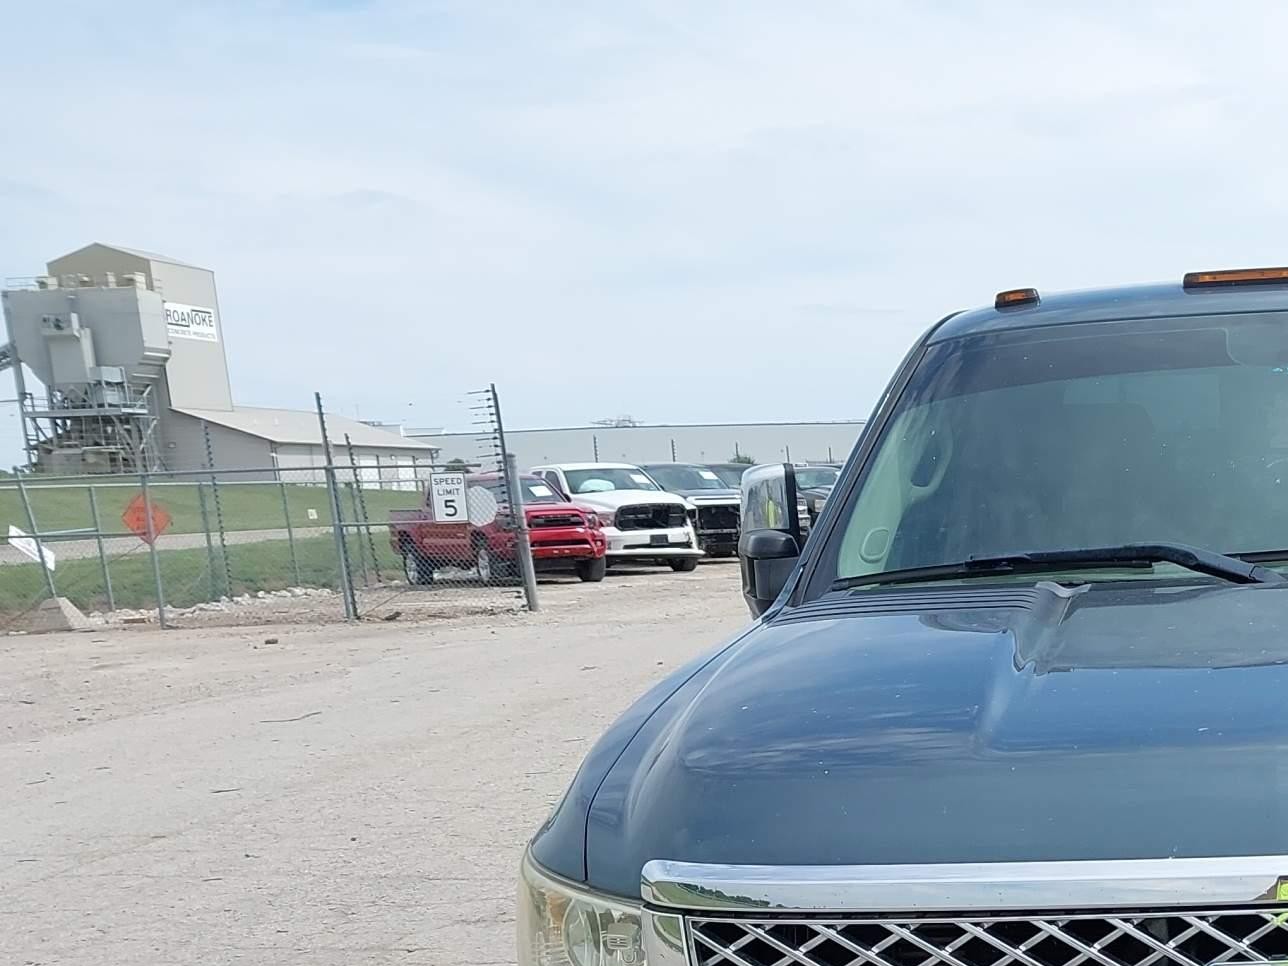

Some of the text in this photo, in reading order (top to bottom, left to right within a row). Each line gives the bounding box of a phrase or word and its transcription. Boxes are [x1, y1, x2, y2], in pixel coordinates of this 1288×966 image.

[165, 309, 214, 327] ROANOKE
[433, 477, 462, 485] SPEED
[437, 488, 460, 496] LIMIT
[444, 499, 457, 517] 5
